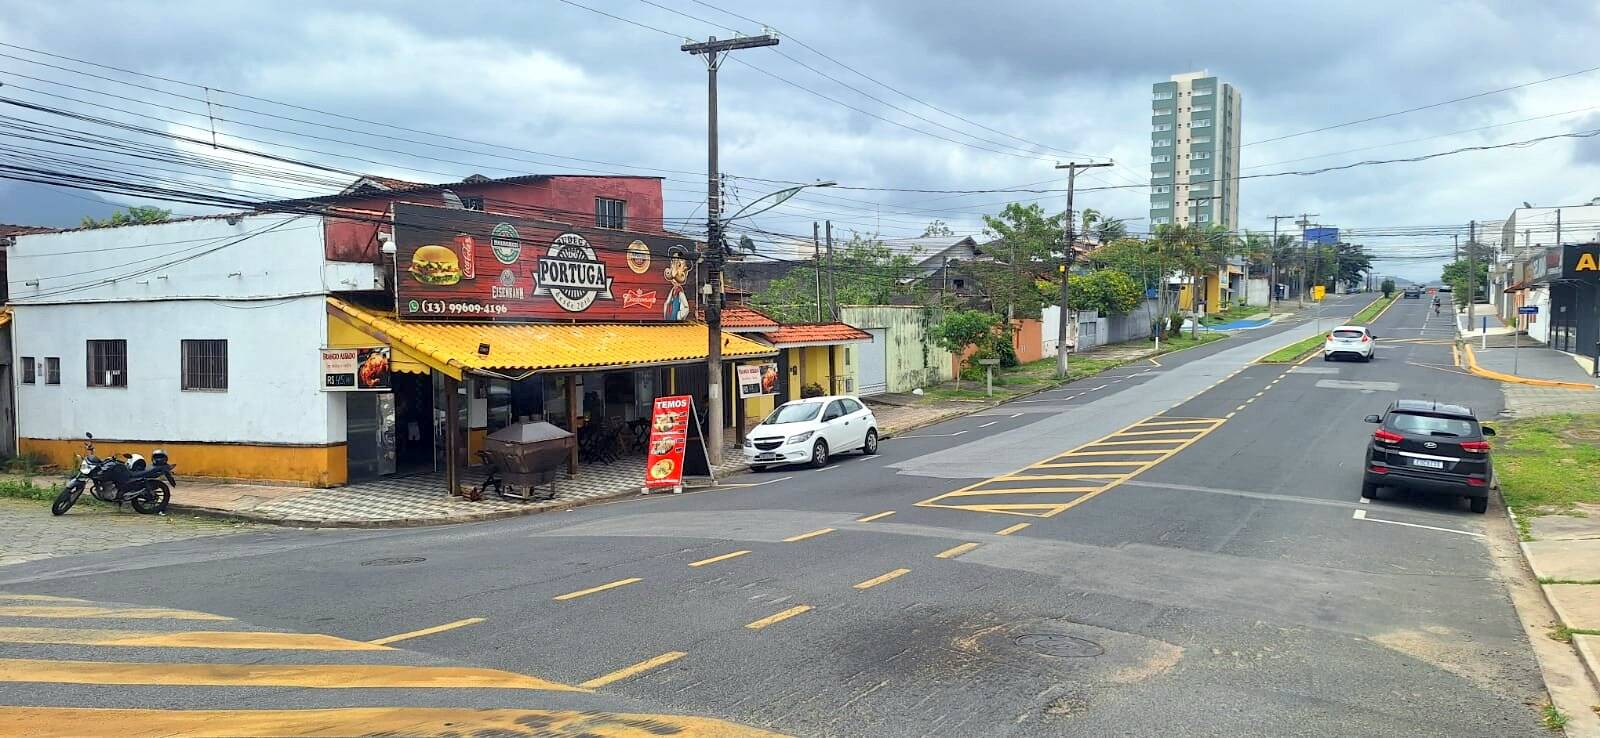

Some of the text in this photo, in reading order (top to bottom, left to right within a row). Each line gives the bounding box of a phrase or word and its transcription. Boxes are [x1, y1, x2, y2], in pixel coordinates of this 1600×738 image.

[1576, 253, 1600, 271] A
[540, 260, 604, 285] PORTUGA
[422, 300, 507, 314] (13) 99609-4196
[656, 399, 687, 409] TEMOS
